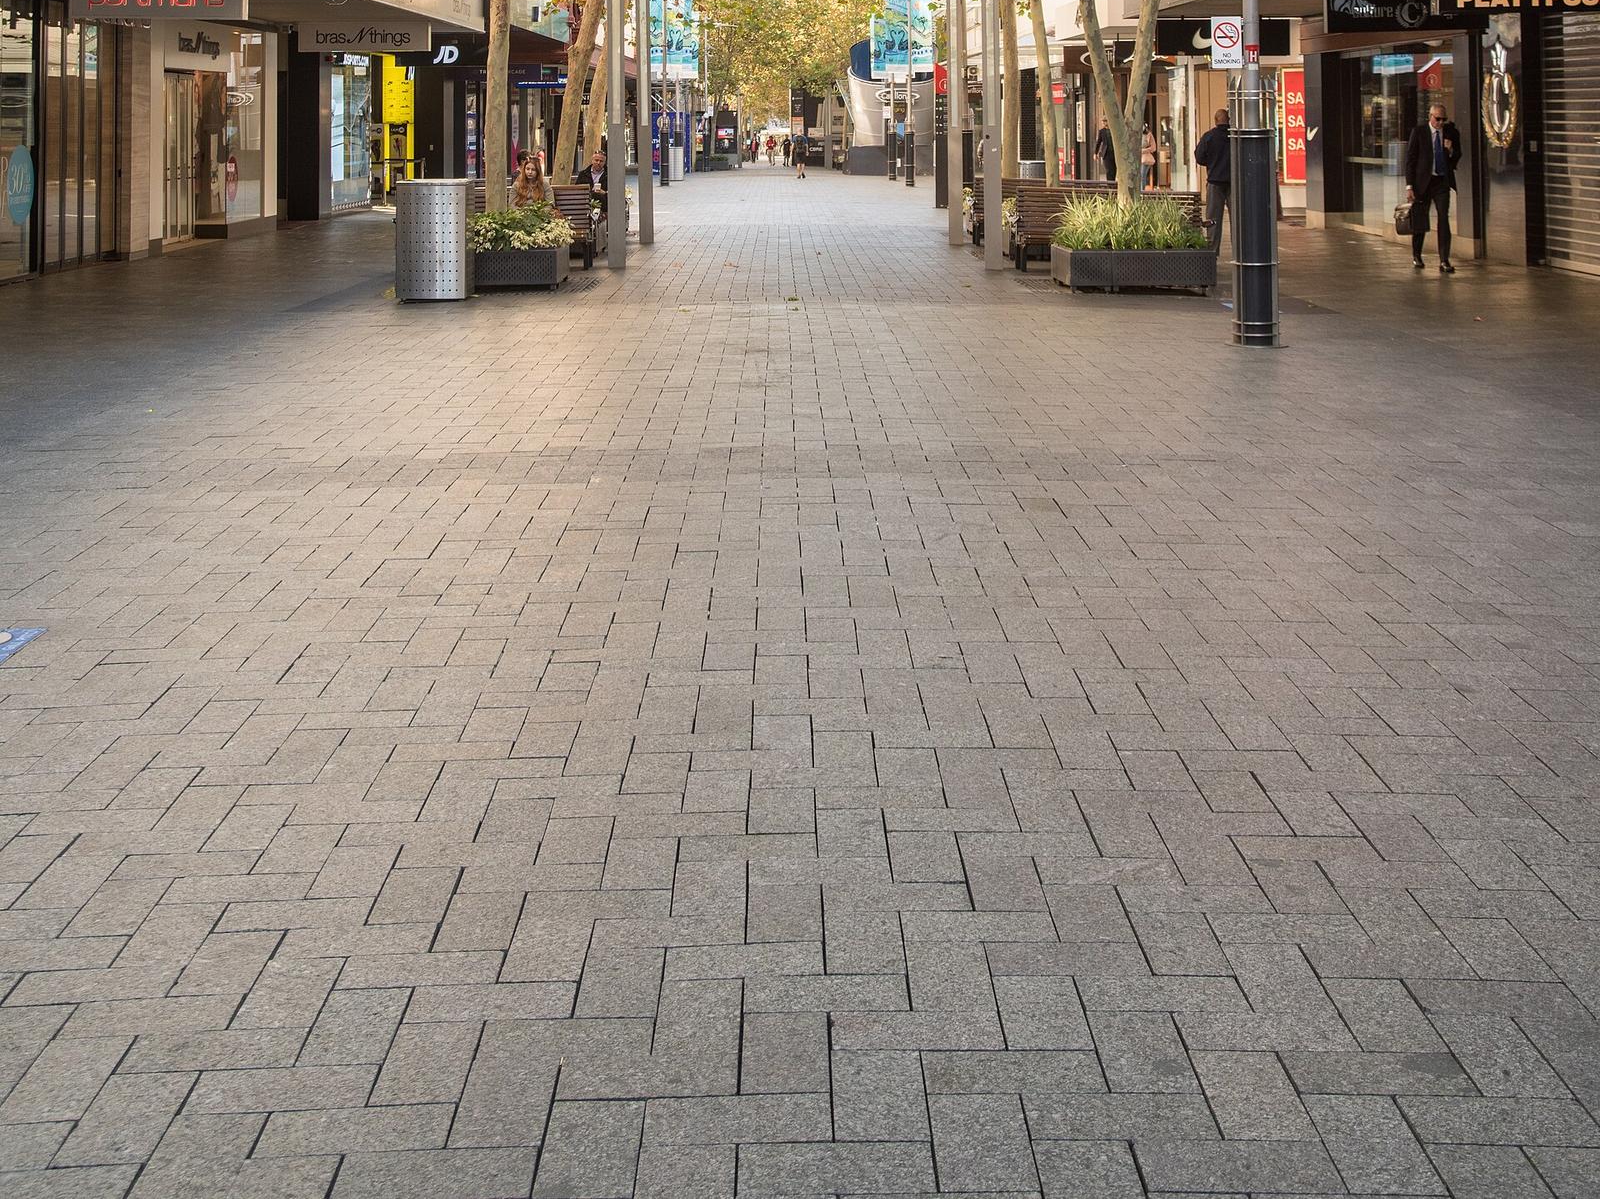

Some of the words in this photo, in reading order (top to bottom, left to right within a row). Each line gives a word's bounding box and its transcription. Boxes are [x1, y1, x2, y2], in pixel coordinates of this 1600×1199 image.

[316, 30, 346, 44] bras
[370, 30, 411, 46] things
[433, 45, 459, 64] JD
